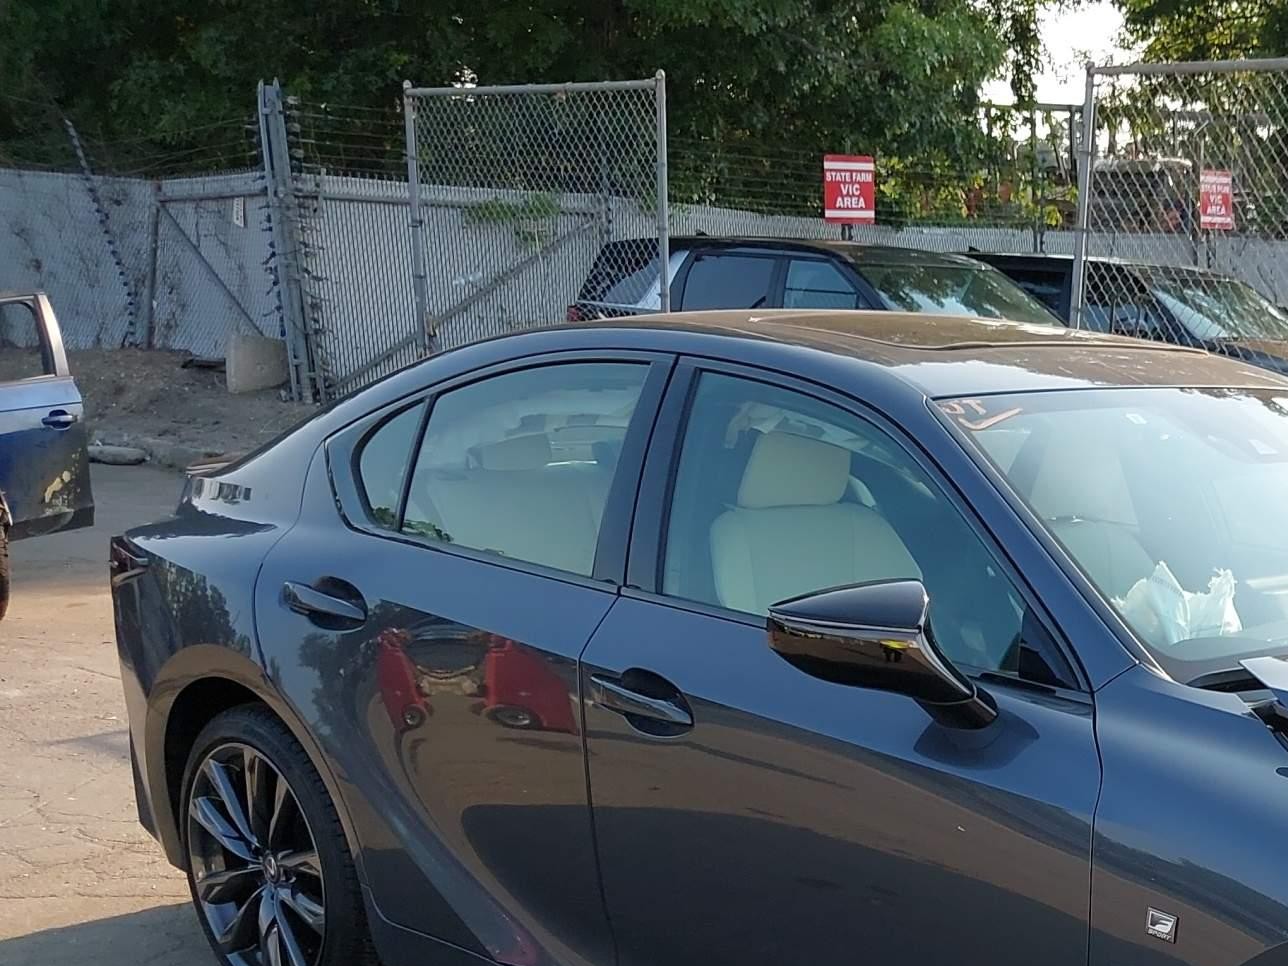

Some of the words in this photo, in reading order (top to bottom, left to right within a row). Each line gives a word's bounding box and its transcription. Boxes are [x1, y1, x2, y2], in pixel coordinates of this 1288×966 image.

[826, 172, 851, 182] STATE
[853, 172, 872, 182] FARM
[840, 183, 861, 195] VIC
[836, 197, 865, 208] AREA
[1147, 928, 1172, 941] SPORT
